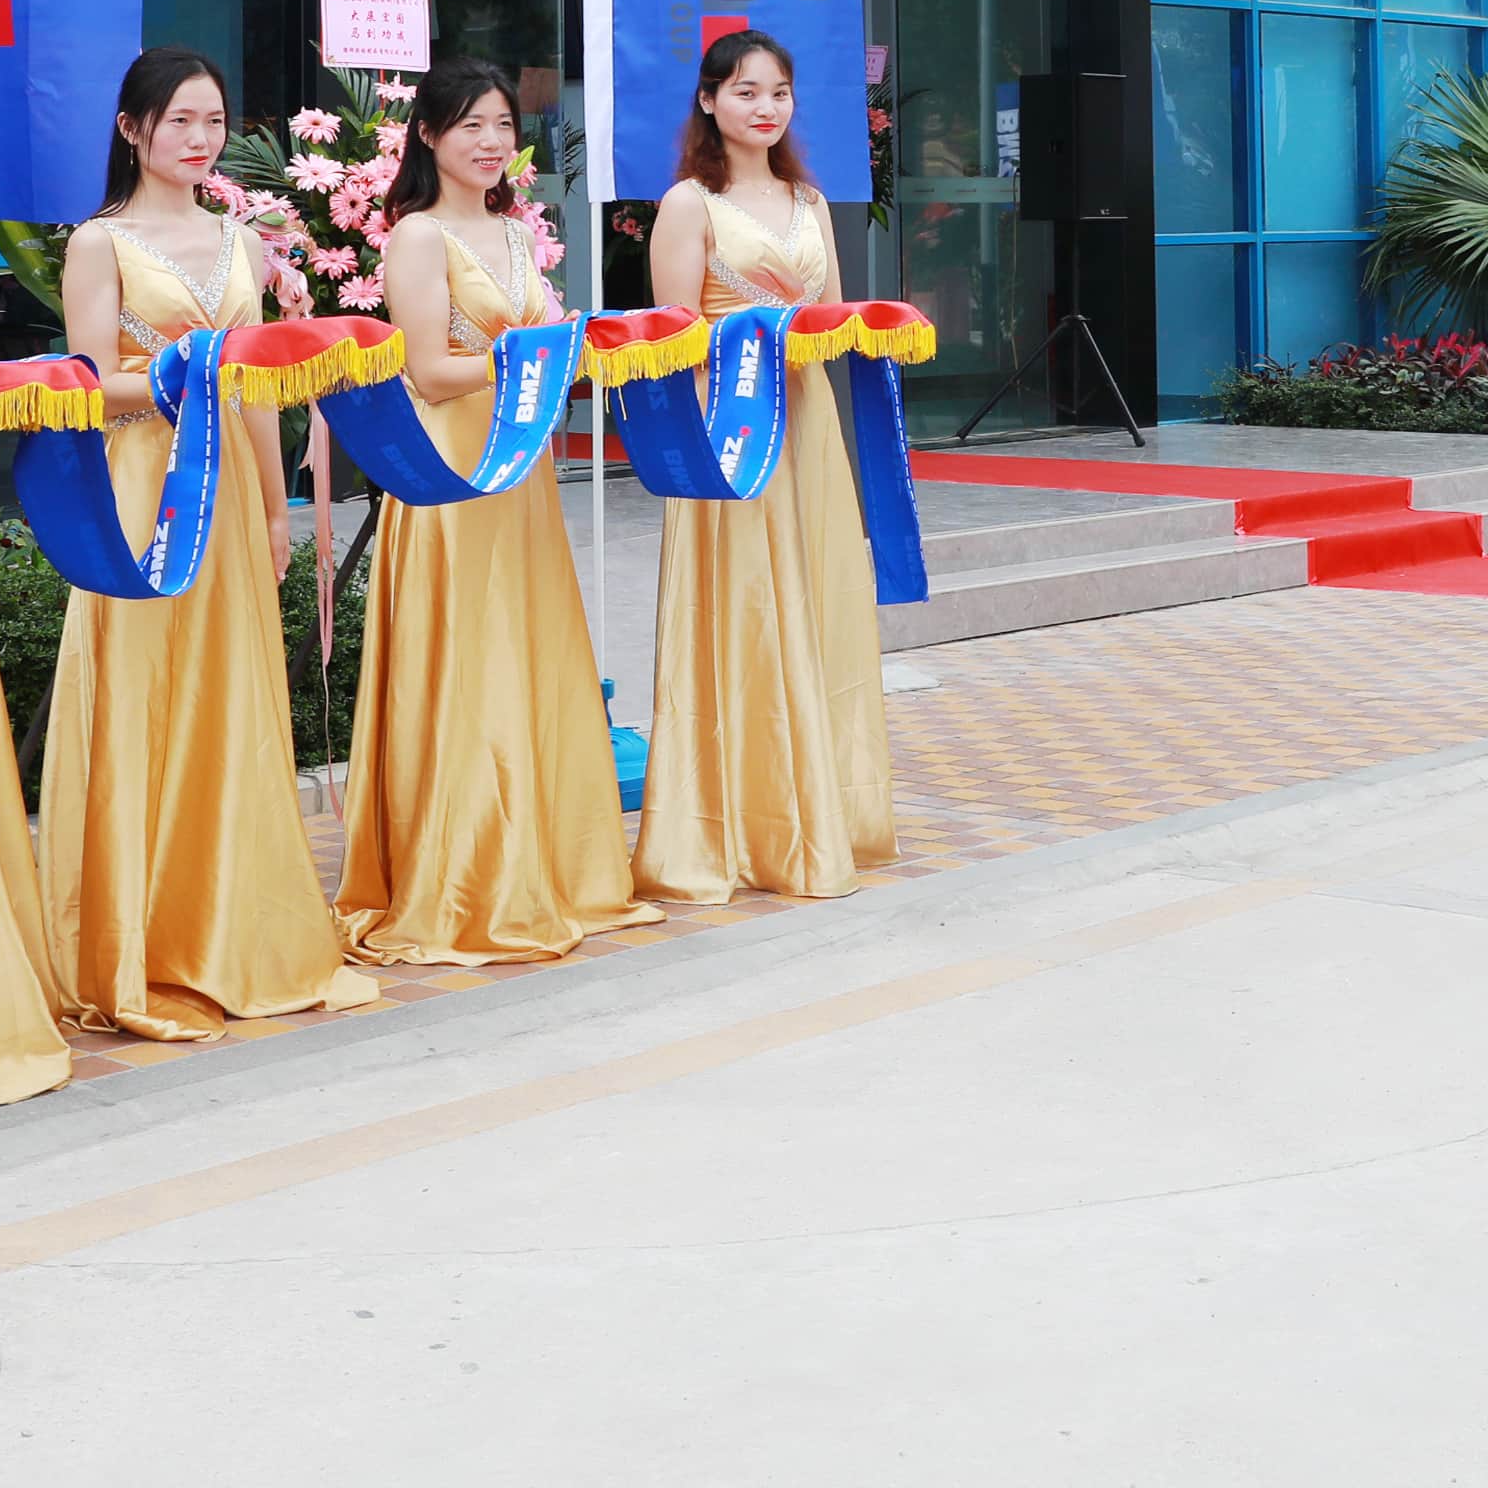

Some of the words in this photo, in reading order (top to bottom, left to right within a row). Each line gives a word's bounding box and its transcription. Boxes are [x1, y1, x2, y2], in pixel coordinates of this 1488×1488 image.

[515, 359, 542, 423] BMZ
[734, 338, 761, 398] BMZ
[719, 436, 744, 482] MZ
